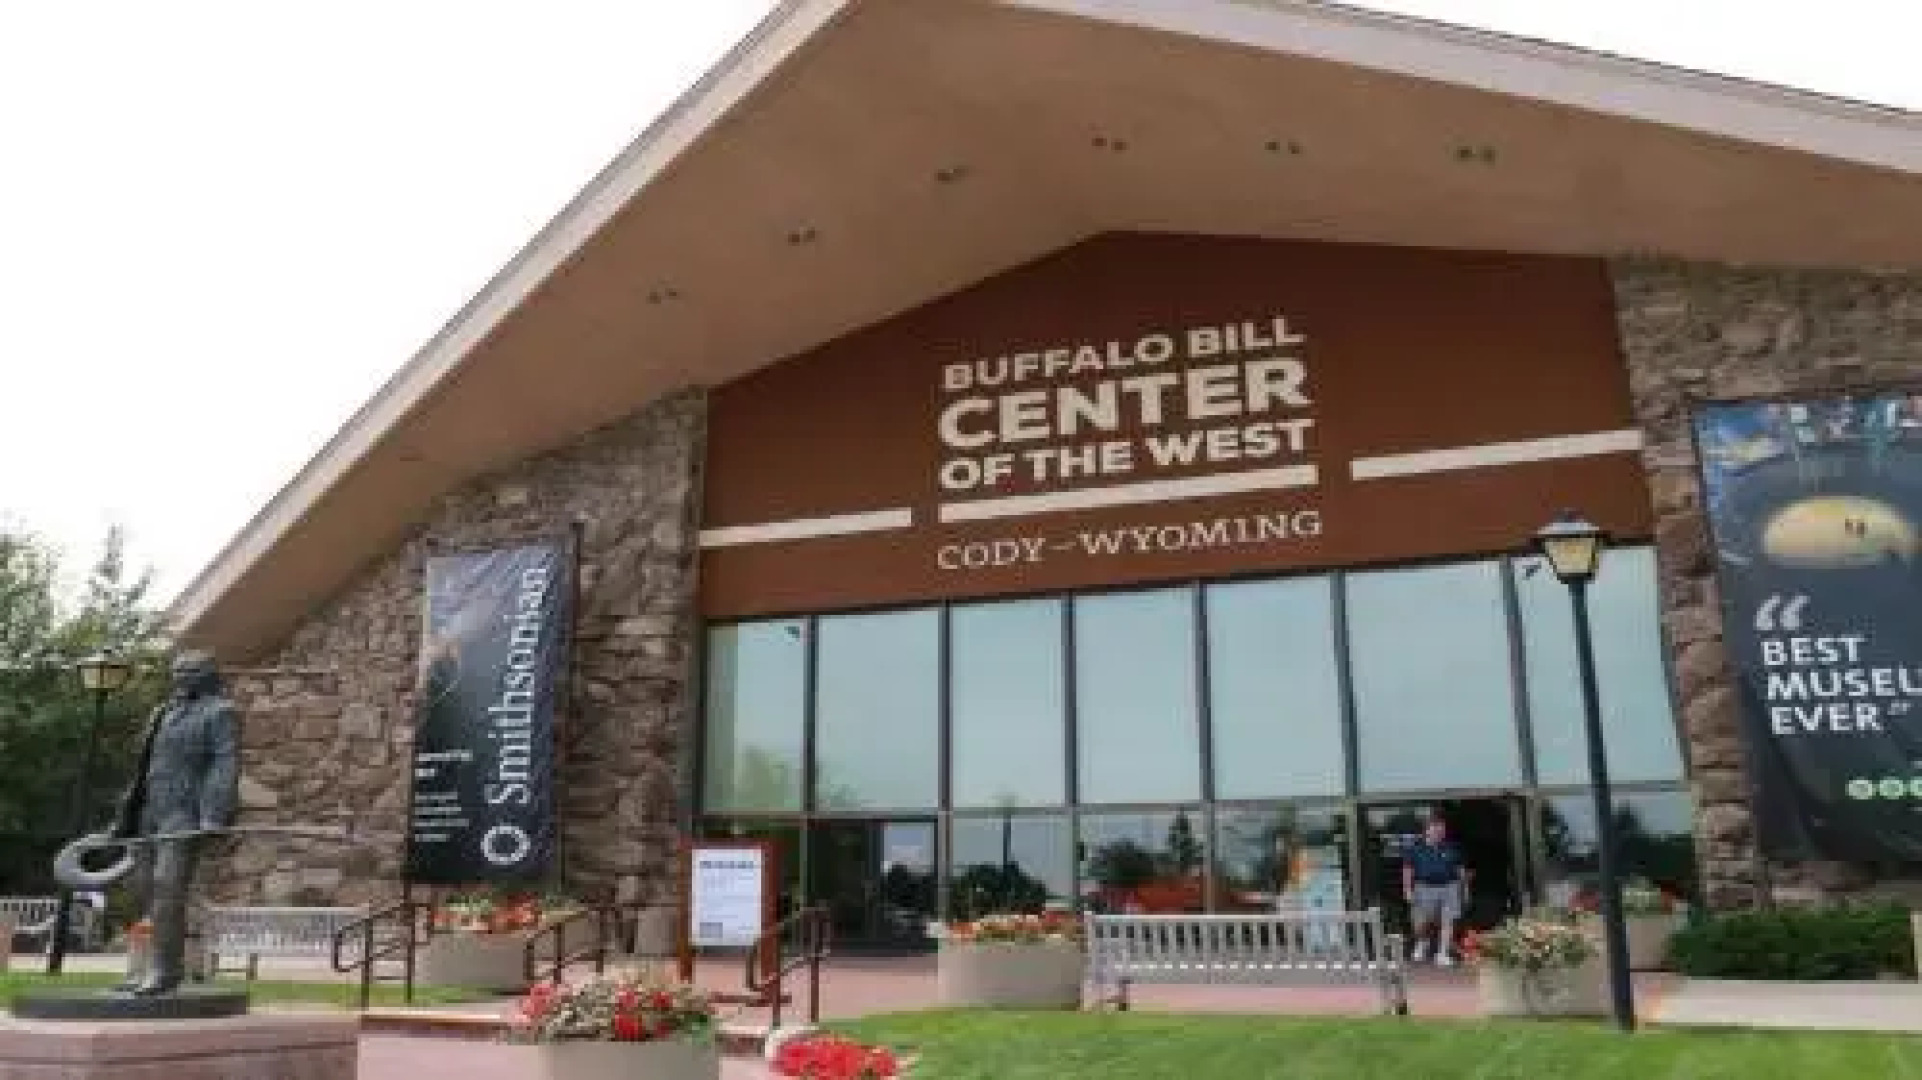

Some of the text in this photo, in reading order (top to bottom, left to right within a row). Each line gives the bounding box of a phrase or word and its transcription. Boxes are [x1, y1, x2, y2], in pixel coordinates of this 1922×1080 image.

[942, 315, 1306, 390] BUFFALO BILL
[938, 357, 1312, 449] CENTER
[939, 419, 1313, 490] OF THE WEST
[938, 511, 1323, 571] CODY WYOMING
[485, 567, 547, 805] Smithsonian
[1761, 635, 1865, 666] BEST
